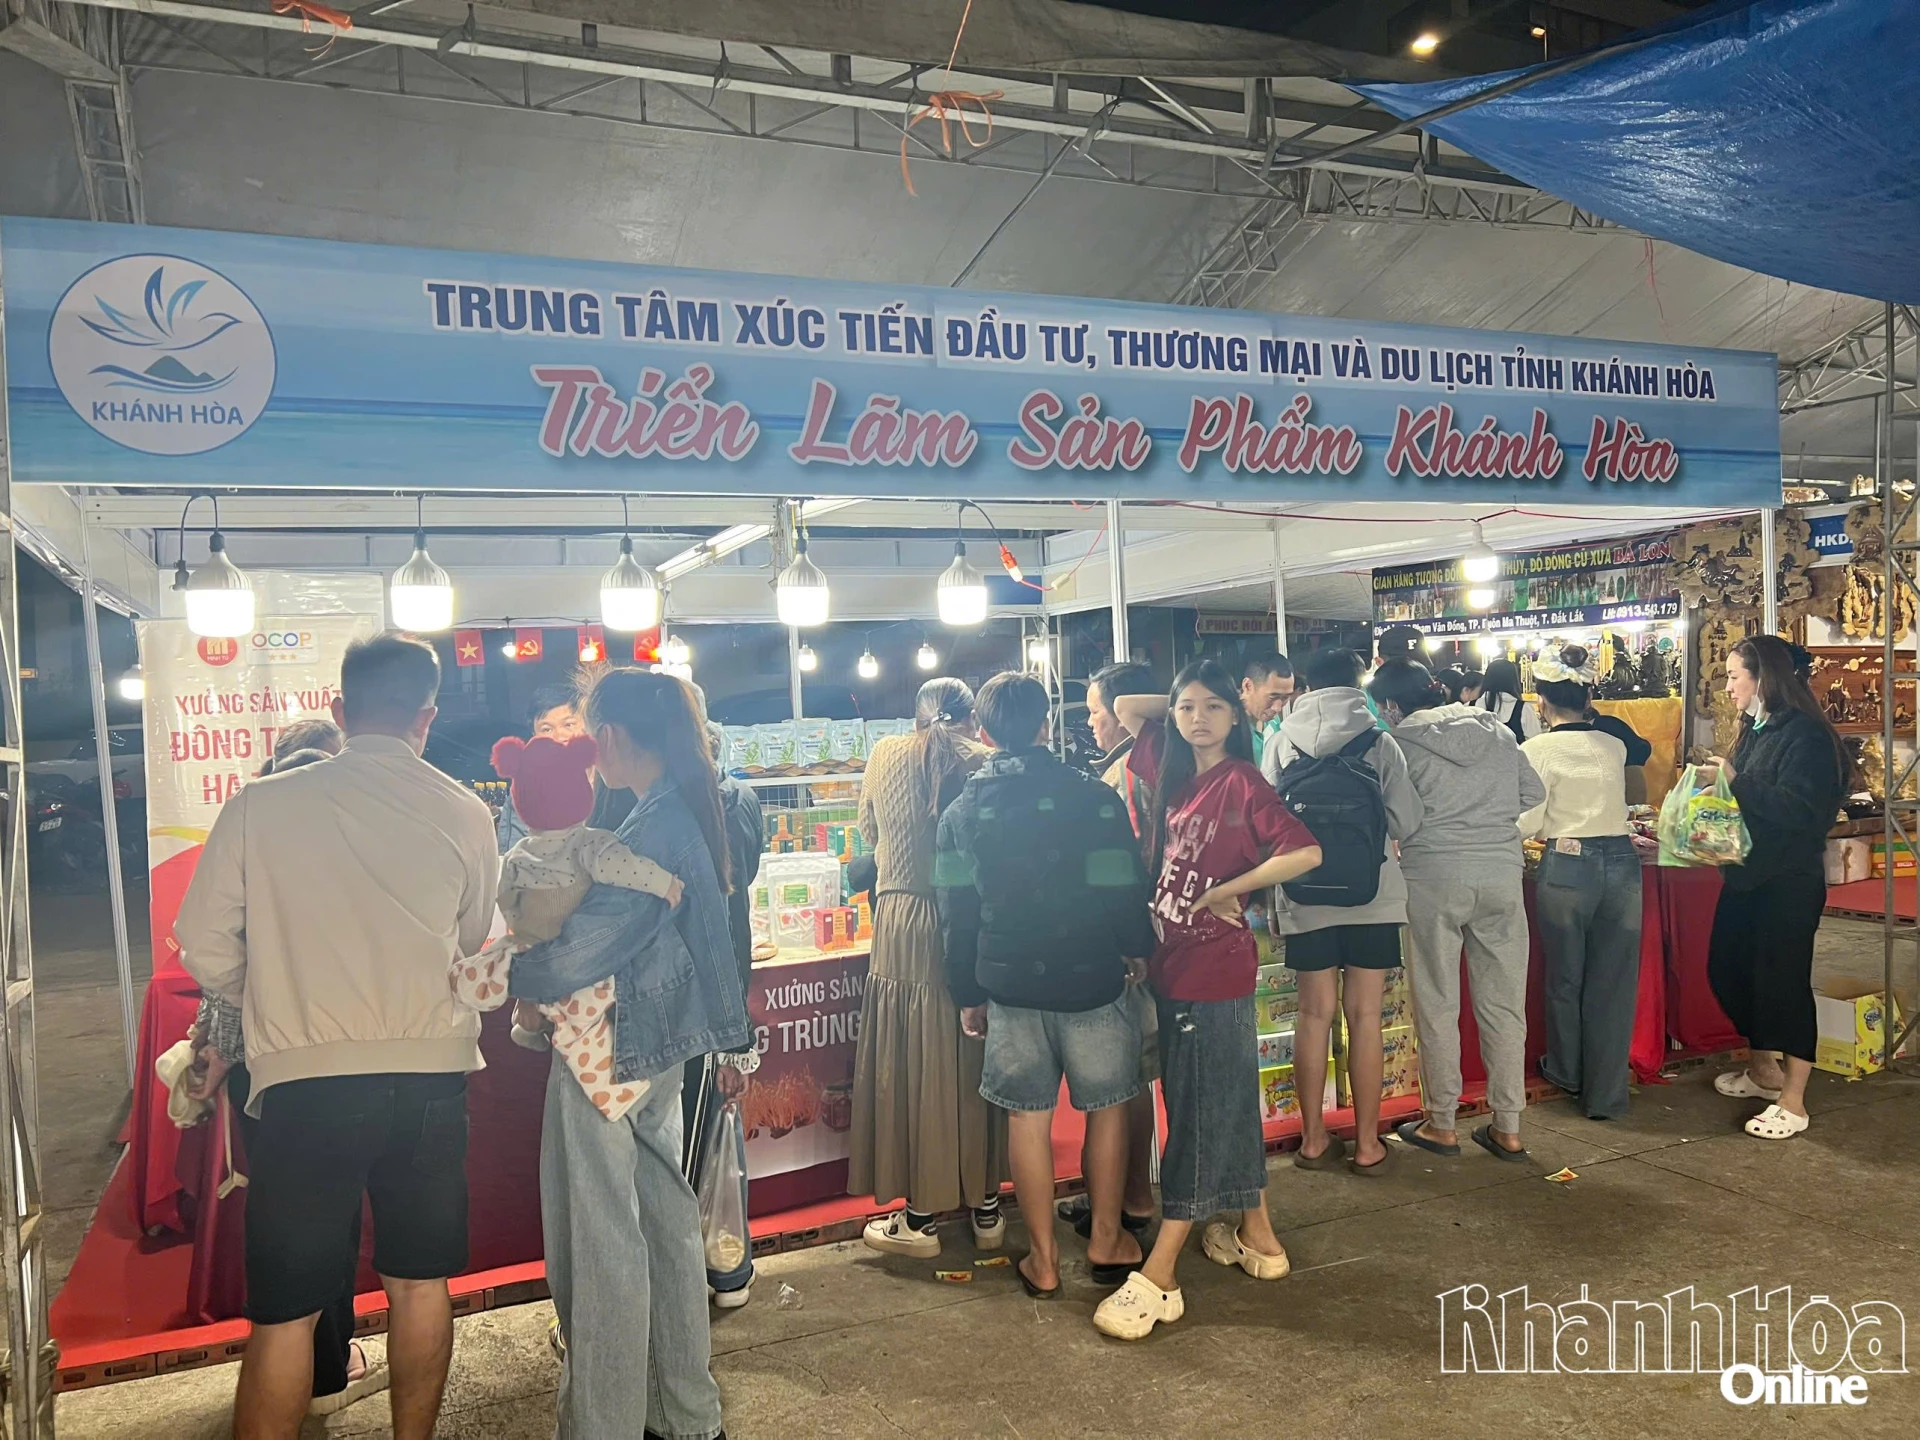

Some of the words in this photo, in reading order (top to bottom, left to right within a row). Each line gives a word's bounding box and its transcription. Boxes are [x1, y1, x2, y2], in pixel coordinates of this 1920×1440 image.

[427, 282, 600, 336] TRUNG
[615, 289, 721, 343] TÂM
[735, 297, 827, 349] XÚC
[838, 302, 934, 357] TIẾN
[945, 307, 1027, 361] ĐẦU
[1038, 321, 1098, 370] TƯ,
[1107, 328, 1249, 374] THƯƠNG
[1259, 337, 1321, 383] MẠI
[1331, 338, 1372, 380] VÀ
[1381, 346, 1421, 382] DU
[1429, 349, 1493, 392] LỊCH
[1500, 346, 1564, 391] TỈNH
[1571, 356, 1659, 398] KHÁNH
[1666, 360, 1716, 400] HÒA
[92, 398, 183, 424] KHÁNH
[192, 401, 243, 425] HÒA
[532, 363, 758, 461] Triển
[790, 379, 978, 467] Lãm
[1009, 390, 1150, 471] Sản
[1178, 391, 1361, 474] Phẩm
[1386, 402, 1562, 477] Khánh
[1582, 413, 1679, 482] Hòa
[1374, 575, 1393, 590] GIAN
[1393, 570, 1414, 588] HÀNG
[1416, 569, 1443, 588] TƯỢNG
[1590, 548, 1612, 566] XƯA
[1613, 541, 1636, 565] BÁ
[251, 632, 312, 648] OCOP
[1468, 619, 1481, 631] TP.
[1502, 616, 1514, 628] Ma
[1541, 613, 1550, 626] T.
[1568, 609, 1585, 623] Lắk
[170, 724, 252, 762] ĐÔNG
[765, 978, 825, 1011] XƯỞNG
[830, 971, 863, 1001] SẢN
[778, 1010, 861, 1053] TRÙNG
